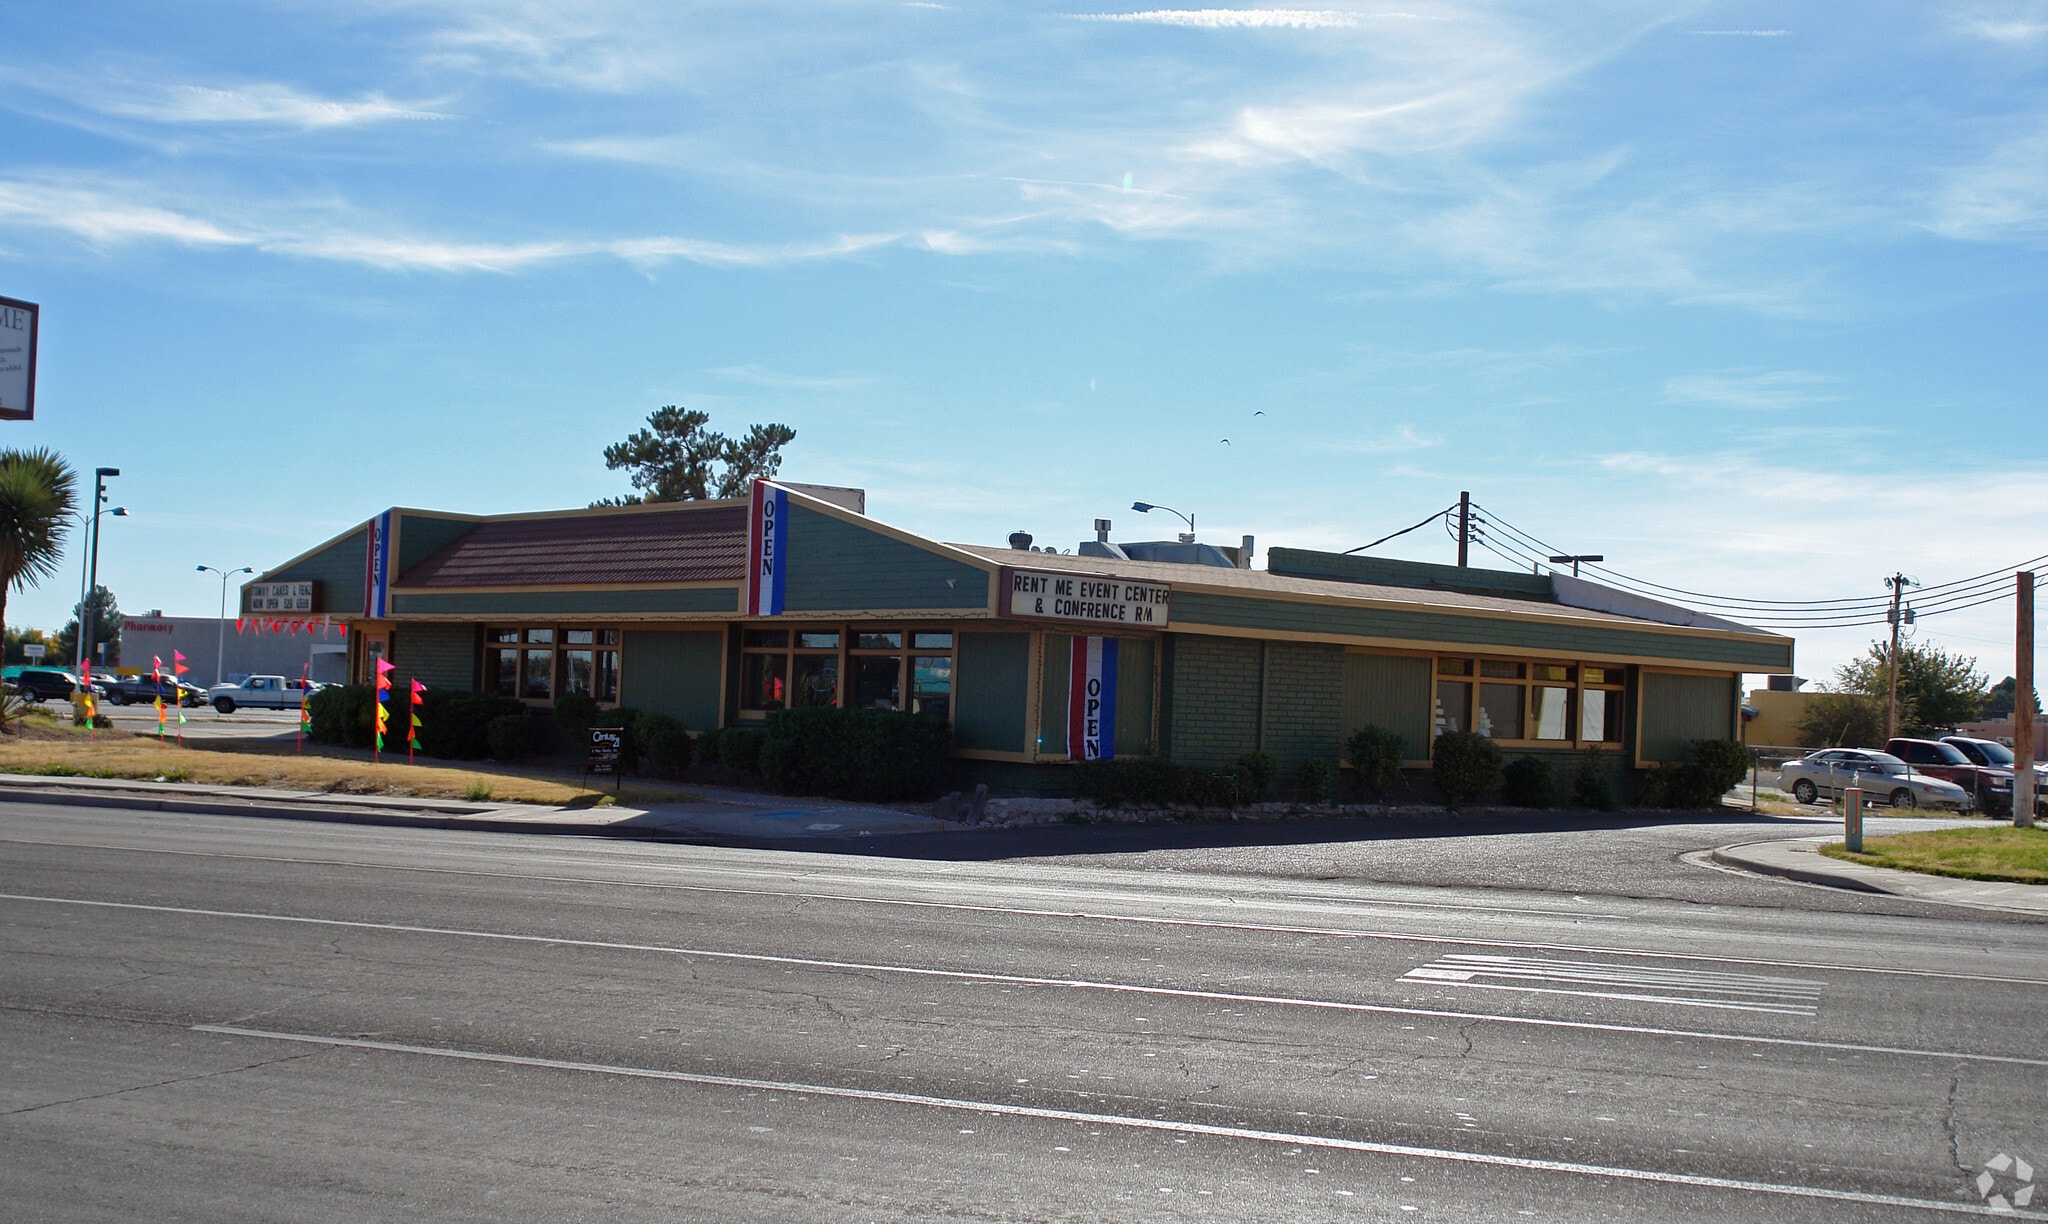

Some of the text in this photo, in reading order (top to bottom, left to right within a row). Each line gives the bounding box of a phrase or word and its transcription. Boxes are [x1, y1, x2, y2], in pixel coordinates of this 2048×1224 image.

[762, 500, 774, 576] OPEN
[373, 527, 381, 587] OPEN
[272, 582, 289, 596] CAKES
[1013, 575, 1170, 605] RENT ME EVENT CENTER
[266, 598, 279, 609] OPEN
[1035, 598, 1044, 614] &
[1055, 599, 1126, 620] CONFRENCE
[124, 621, 173, 635] Pharmacy
[1087, 678, 1100, 757] OPEN
